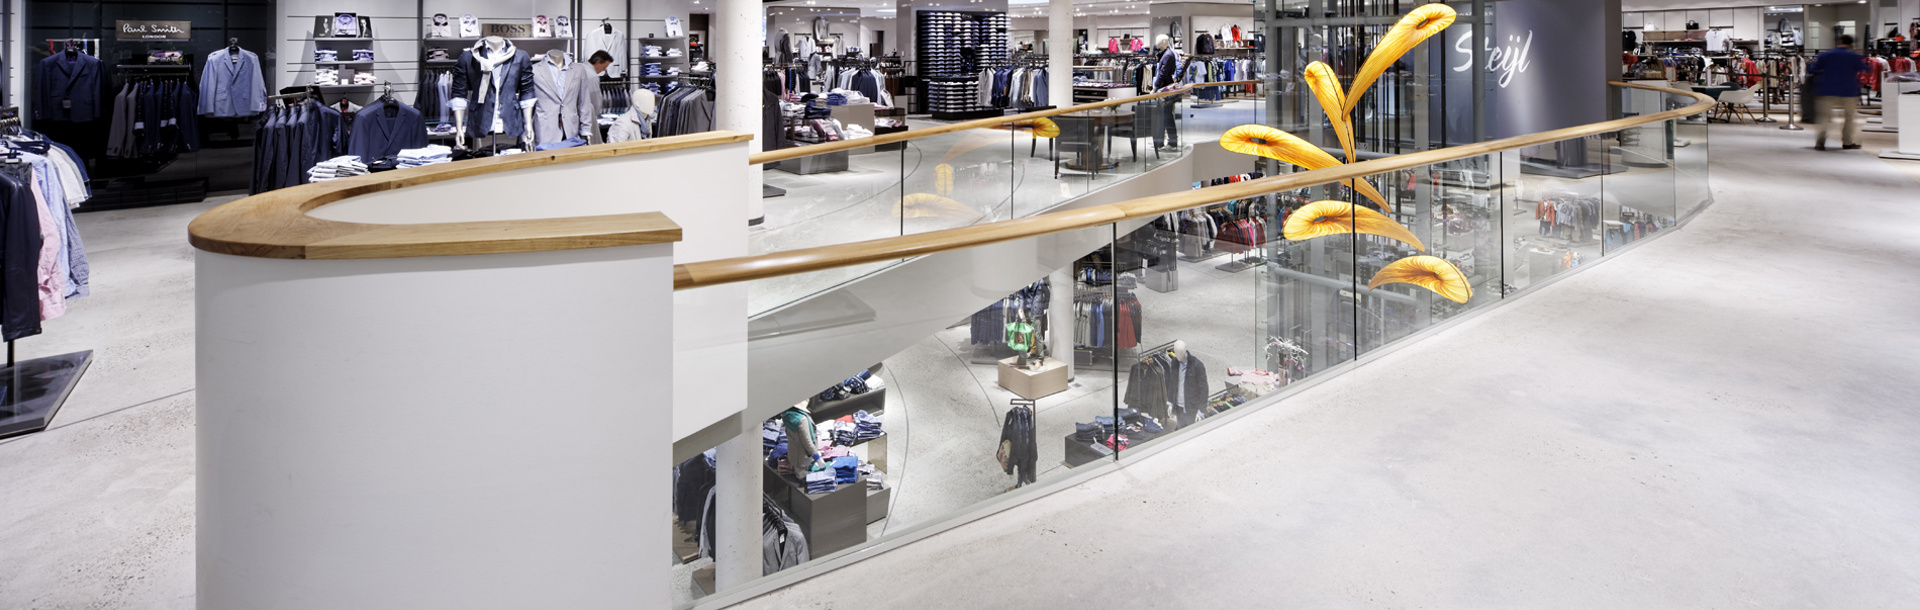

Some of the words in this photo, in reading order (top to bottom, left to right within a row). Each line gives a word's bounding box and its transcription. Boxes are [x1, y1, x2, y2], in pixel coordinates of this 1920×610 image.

[123, 23, 147, 33] Paul
[151, 24, 185, 33] Smith
[491, 24, 526, 33] BOSS
